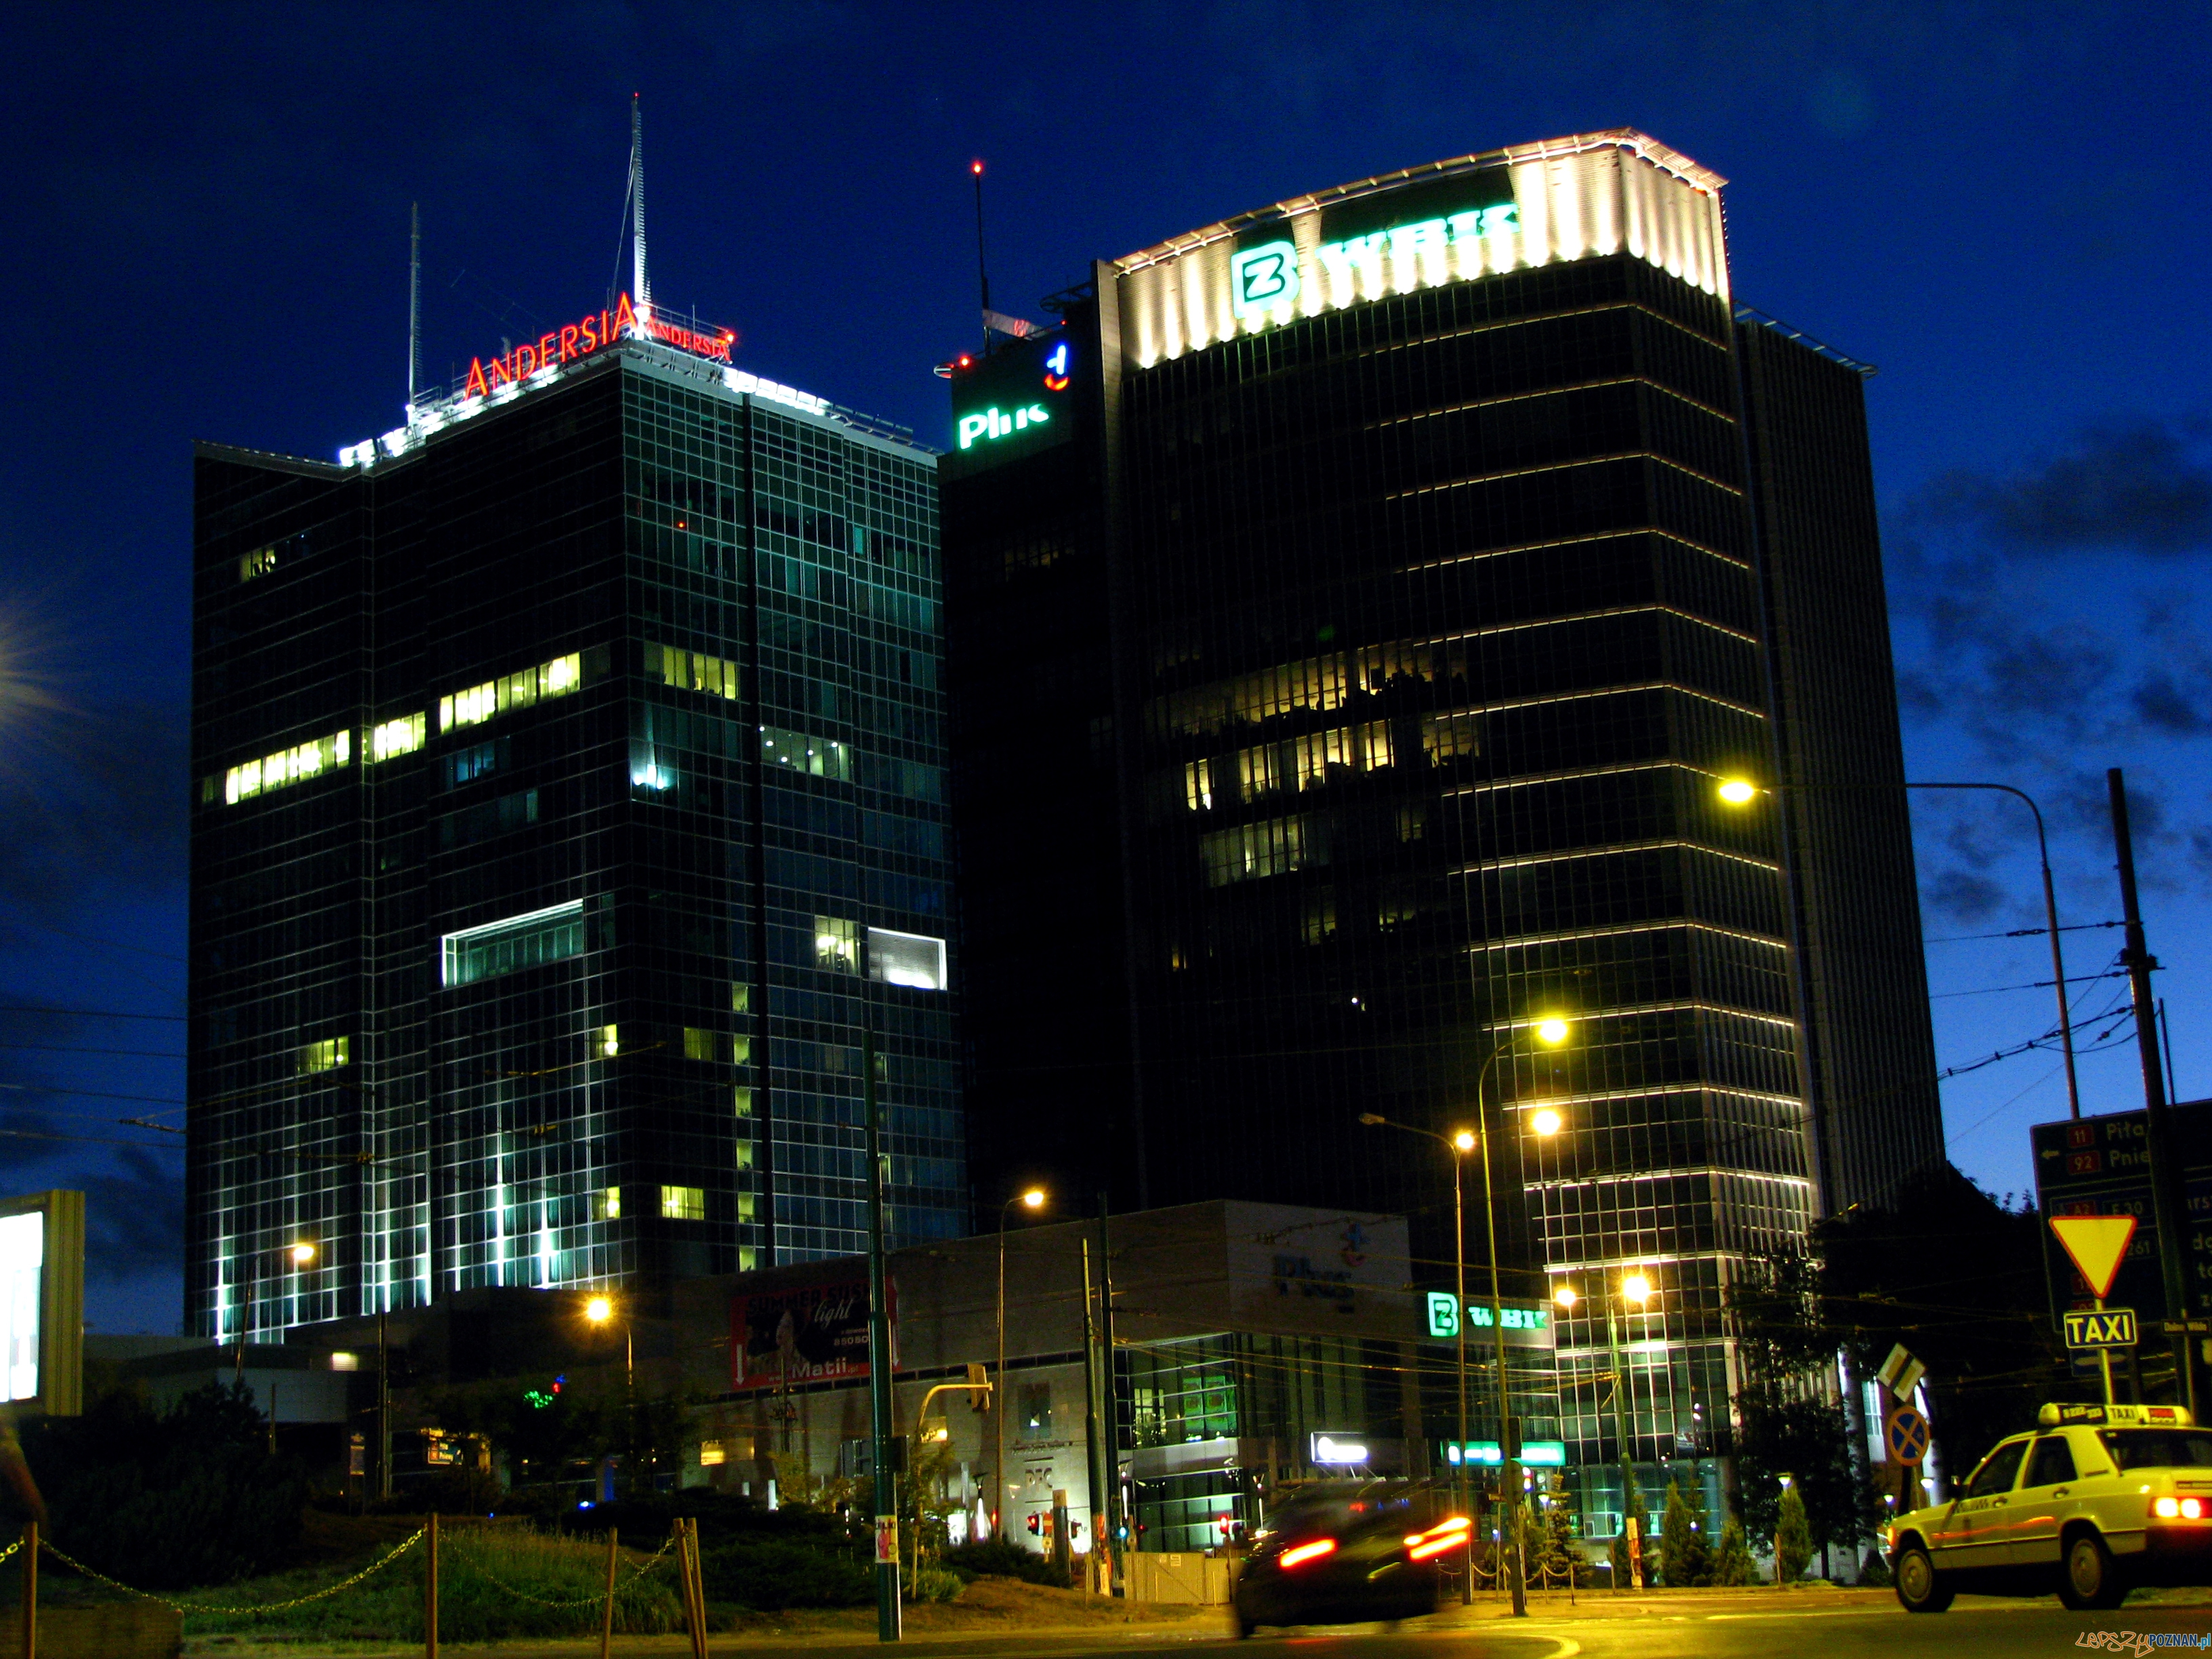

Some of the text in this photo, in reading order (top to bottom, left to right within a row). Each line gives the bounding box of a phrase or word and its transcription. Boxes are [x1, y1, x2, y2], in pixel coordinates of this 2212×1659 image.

[464, 291, 638, 401] ANDERSIA
[645, 316, 731, 361] ANDERSIA
[2074, 1129, 2087, 1144] 11
[2074, 1145, 2150, 1172] 92 Pnie
[814, 1298, 855, 1330] light
[1468, 1306, 1548, 1329] WBK
[2067, 1314, 2133, 1344] TAXI
[2108, 1407, 2135, 1420] TAXI
